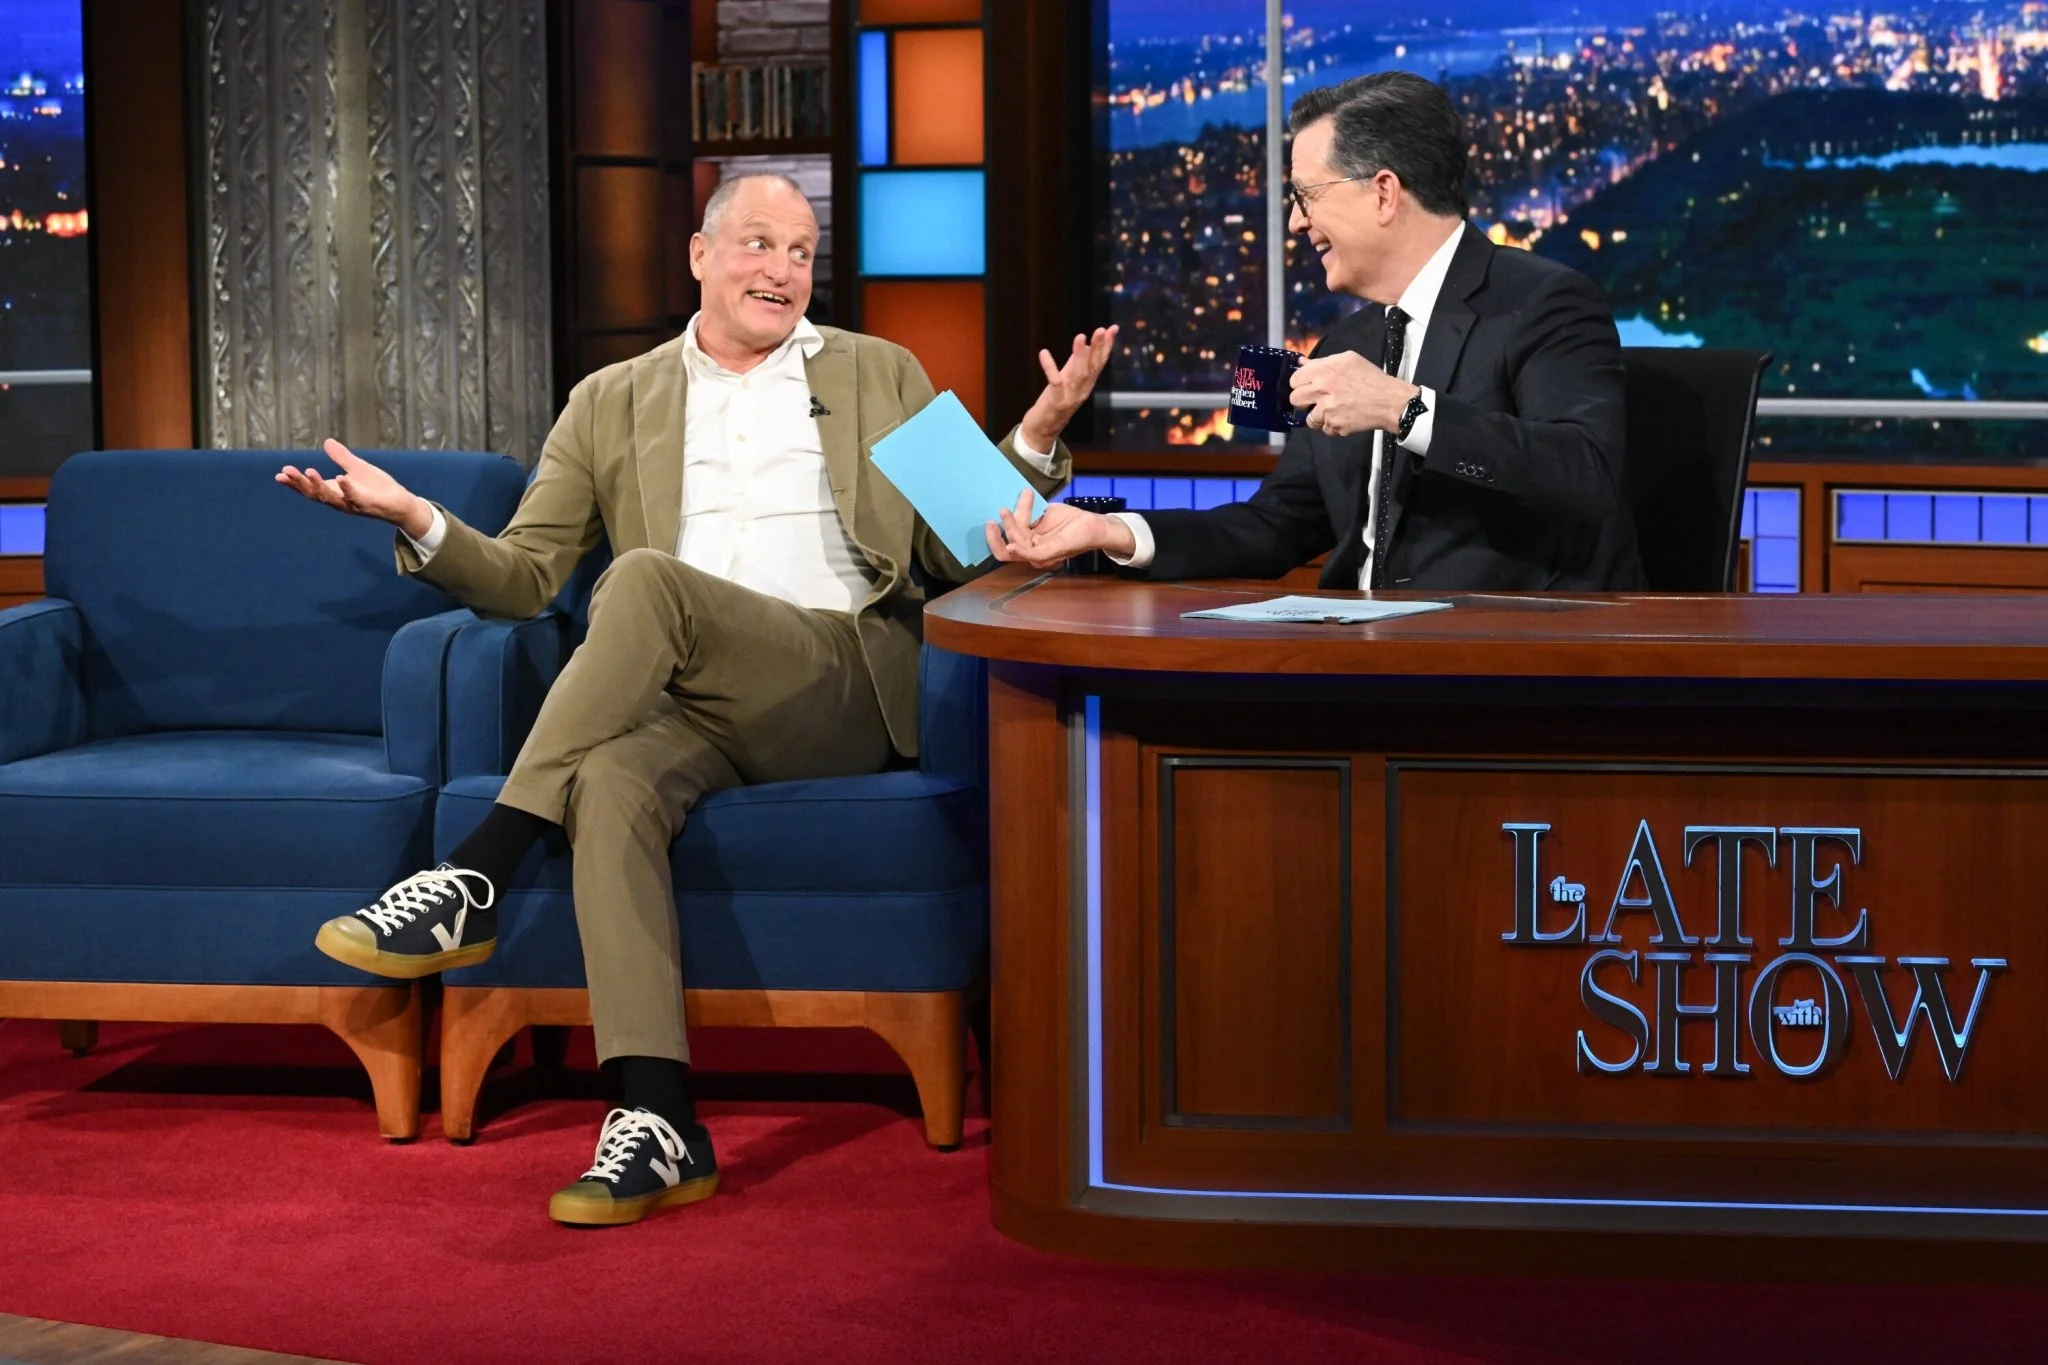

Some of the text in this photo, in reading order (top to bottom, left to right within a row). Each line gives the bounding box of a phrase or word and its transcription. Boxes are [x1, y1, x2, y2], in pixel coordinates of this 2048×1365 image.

[1236, 377, 1265, 391] SHOW
[1502, 819, 1867, 949] the LATE
[1577, 949, 2008, 1081] SHOW
[1773, 999, 1823, 1026] with
